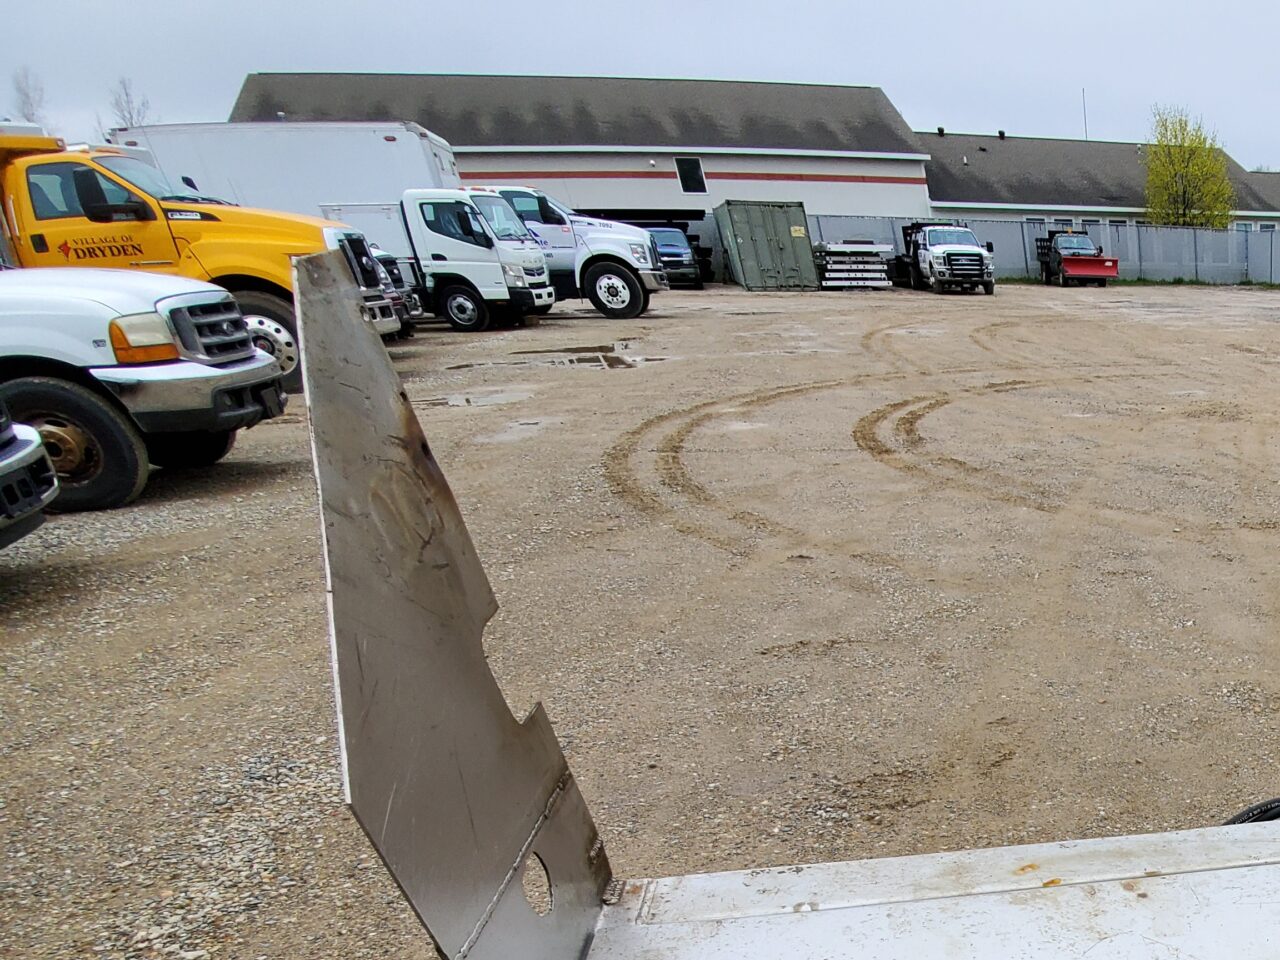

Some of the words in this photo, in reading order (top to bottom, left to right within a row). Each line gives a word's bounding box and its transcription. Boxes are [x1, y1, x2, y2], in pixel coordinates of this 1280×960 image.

[72, 236, 118, 245] VILLAGE
[121, 235, 133, 243] OF
[72, 244, 144, 260] DRYDEN
